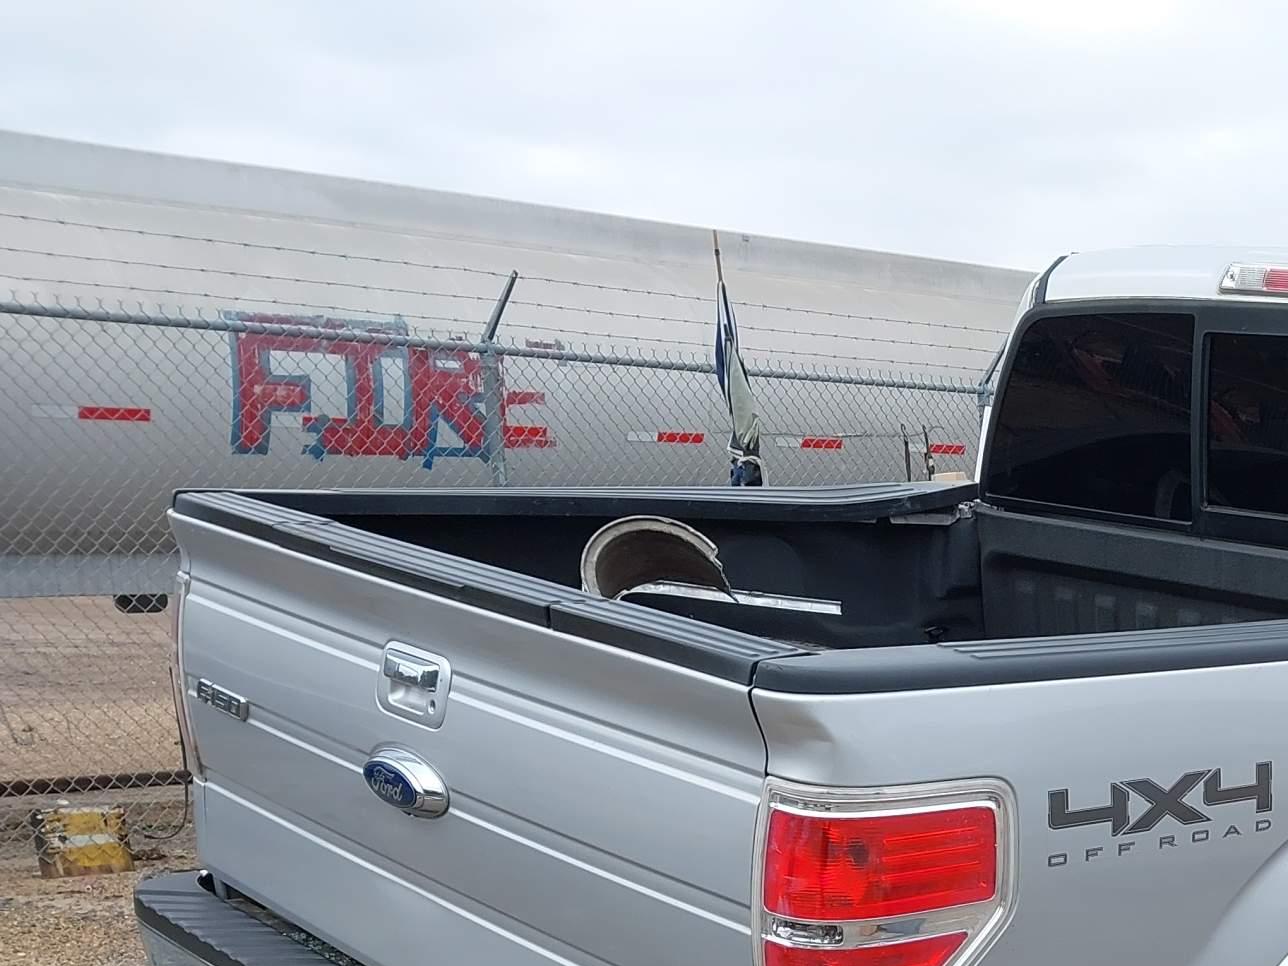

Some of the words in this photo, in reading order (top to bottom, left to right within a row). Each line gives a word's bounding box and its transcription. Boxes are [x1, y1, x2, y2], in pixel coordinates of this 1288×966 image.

[371, 766, 404, 801] Ford
[1047, 841, 1136, 868] OFF
[1158, 819, 1272, 850] ROAD
